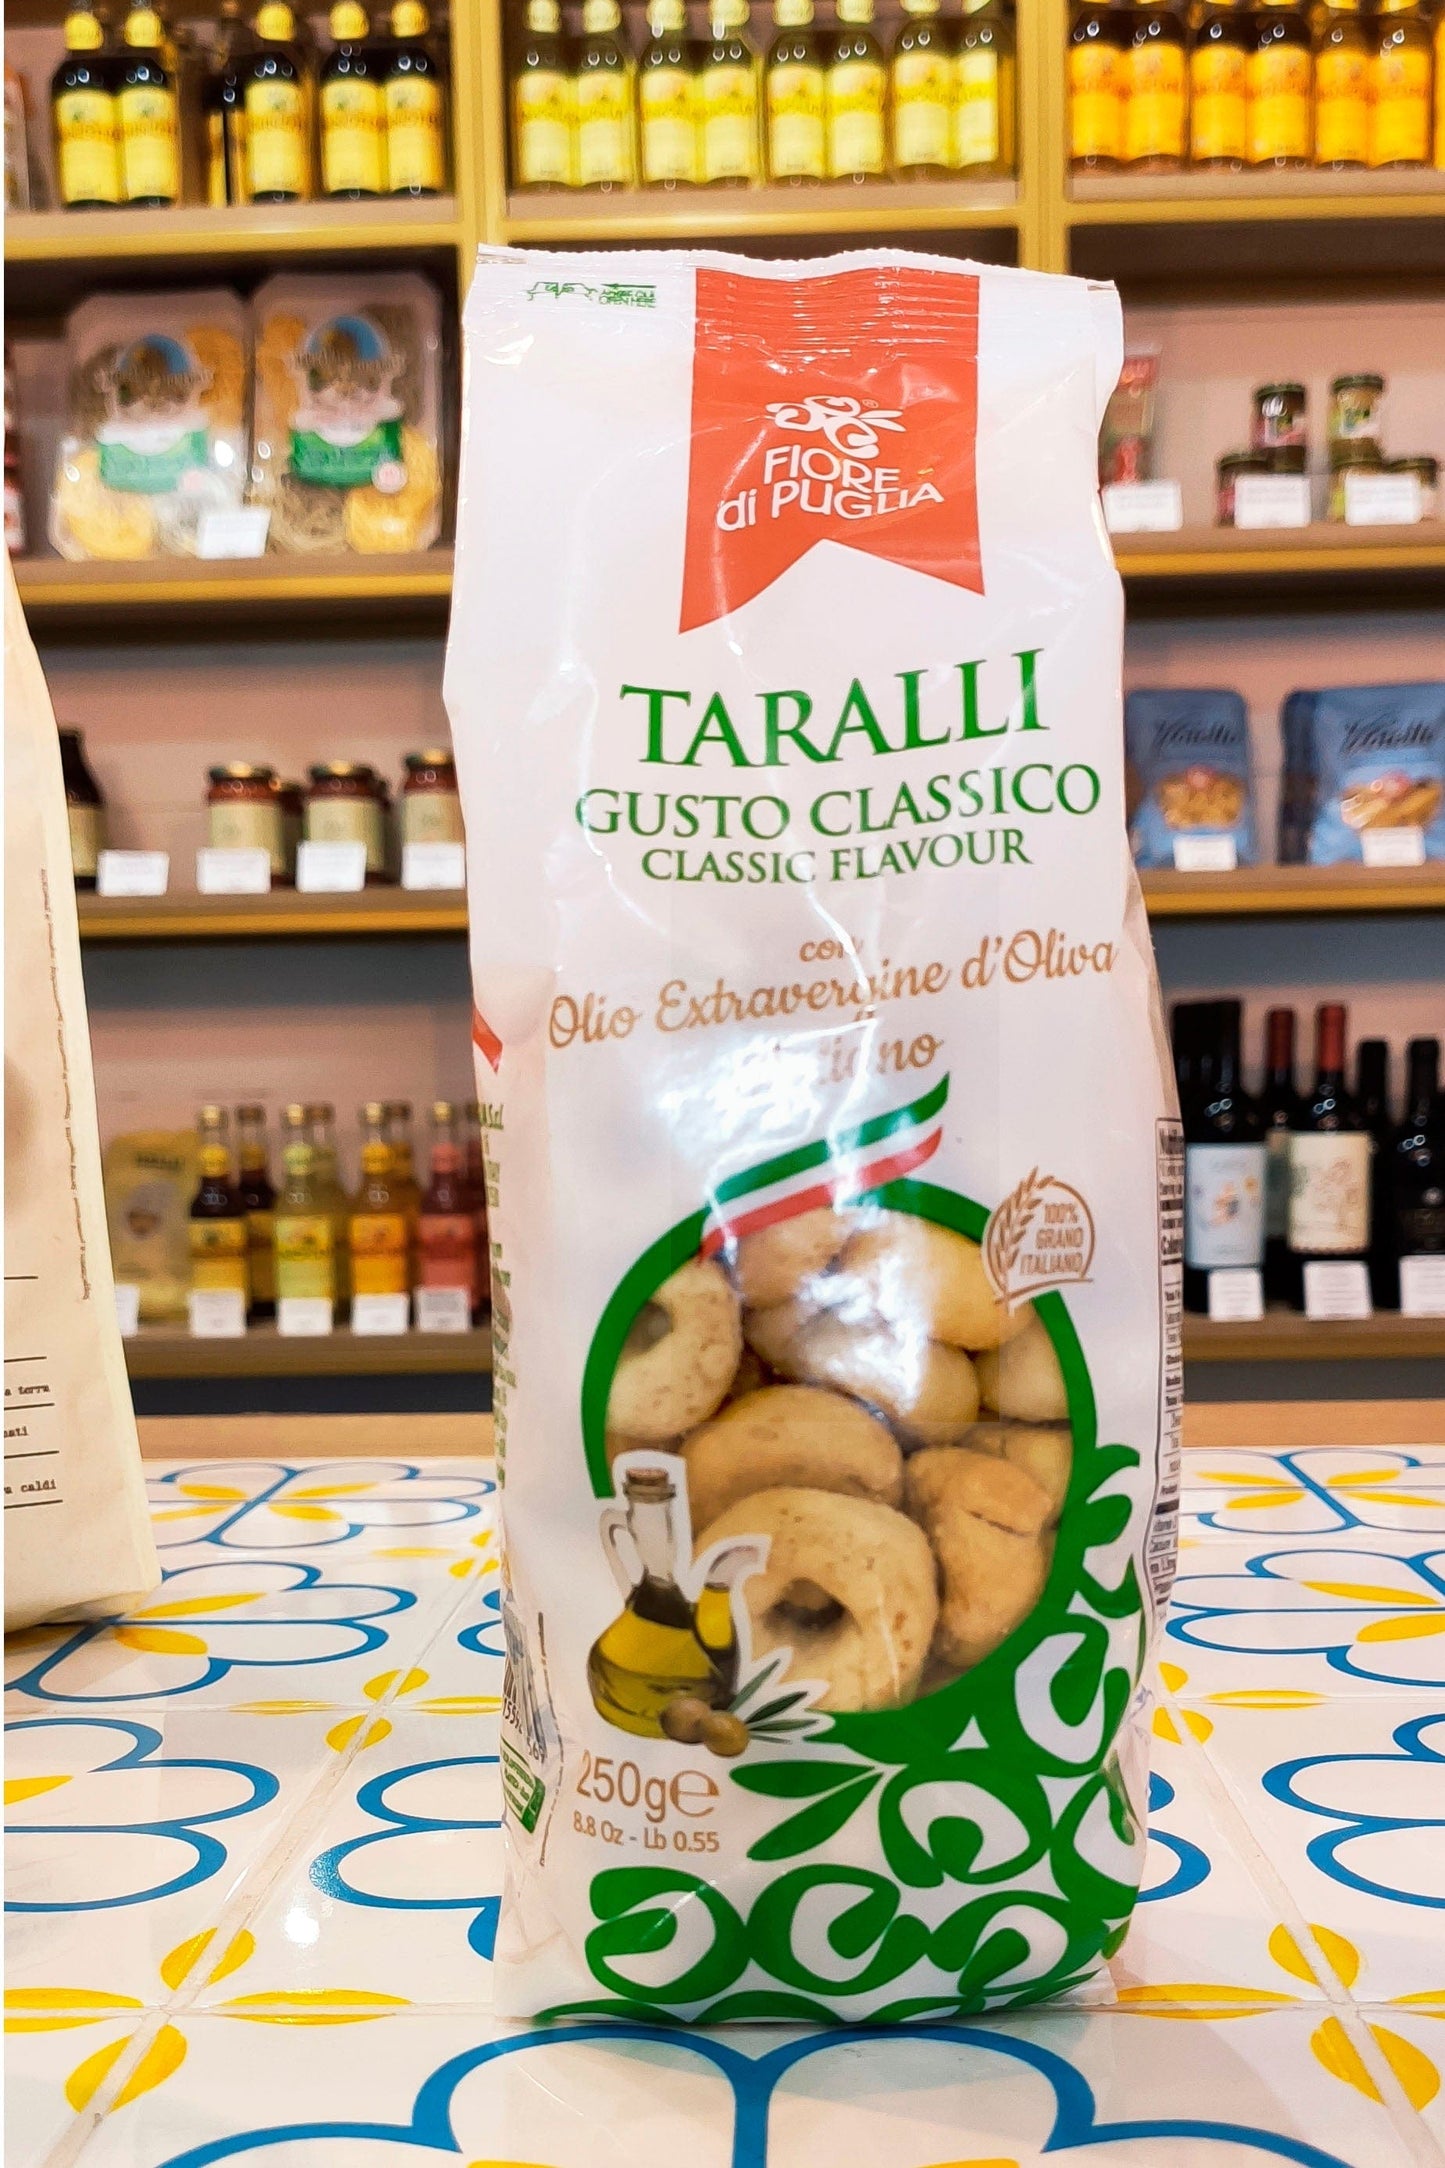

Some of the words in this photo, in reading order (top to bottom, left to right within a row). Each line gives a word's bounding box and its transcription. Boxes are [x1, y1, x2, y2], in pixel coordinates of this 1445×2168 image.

[763, 444, 901, 493] FIORE
[716, 488, 758, 532] di
[771, 477, 945, 520] PUGLIA
[619, 647, 1051, 768] TARALLI
[575, 787, 791, 841] GUSTO
[809, 762, 1101, 837] CLASSICO
[641, 846, 816, 884] CLASSIC
[829, 827, 1035, 882] FLAVOUR
[549, 991, 643, 1049] Olio
[1044, 1203, 1078, 1223] 100%
[1036, 1227, 1084, 1250] GRANO
[1019, 1252, 1083, 1275] ITALIANO
[18, 1384, 50, 1395] terra
[20, 1479, 56, 1493] caldi
[573, 1809, 597, 1837] 8.8
[600, 1820, 625, 1846] Oz
[643, 1827, 668, 1851] Lb
[673, 1830, 720, 1853] 0.55
